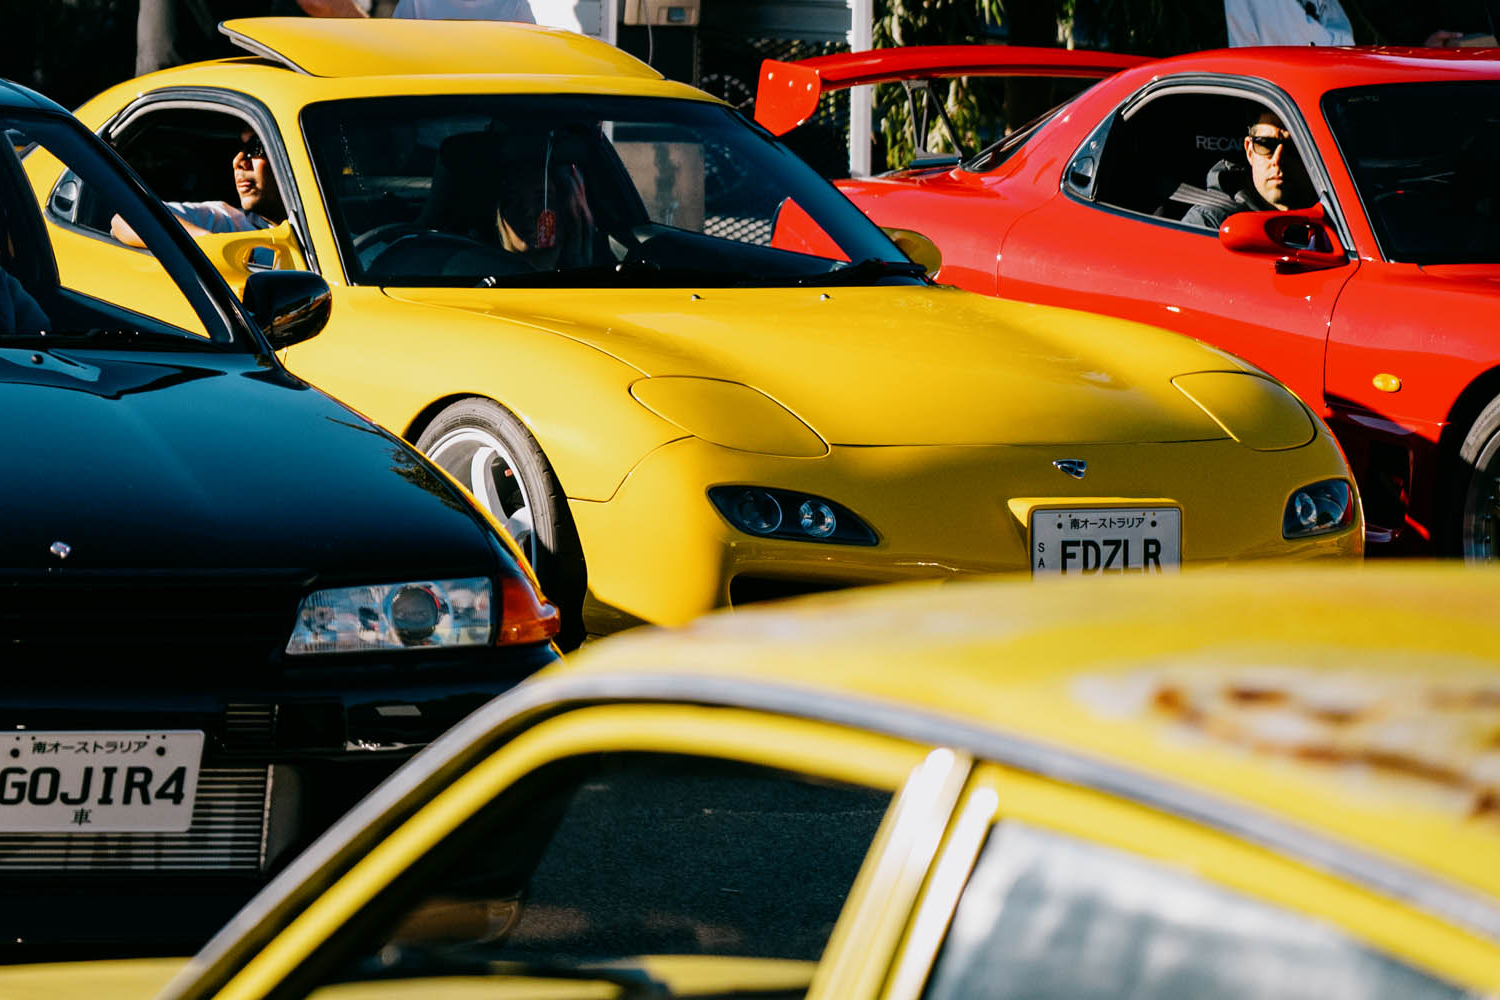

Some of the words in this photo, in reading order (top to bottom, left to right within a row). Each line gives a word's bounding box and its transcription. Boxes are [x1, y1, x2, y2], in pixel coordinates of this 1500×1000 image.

[1070, 517, 1145, 530] 南オーストラリア
[31, 740, 148, 755] 南オーストラリア
[70, 808, 92, 827] 車
